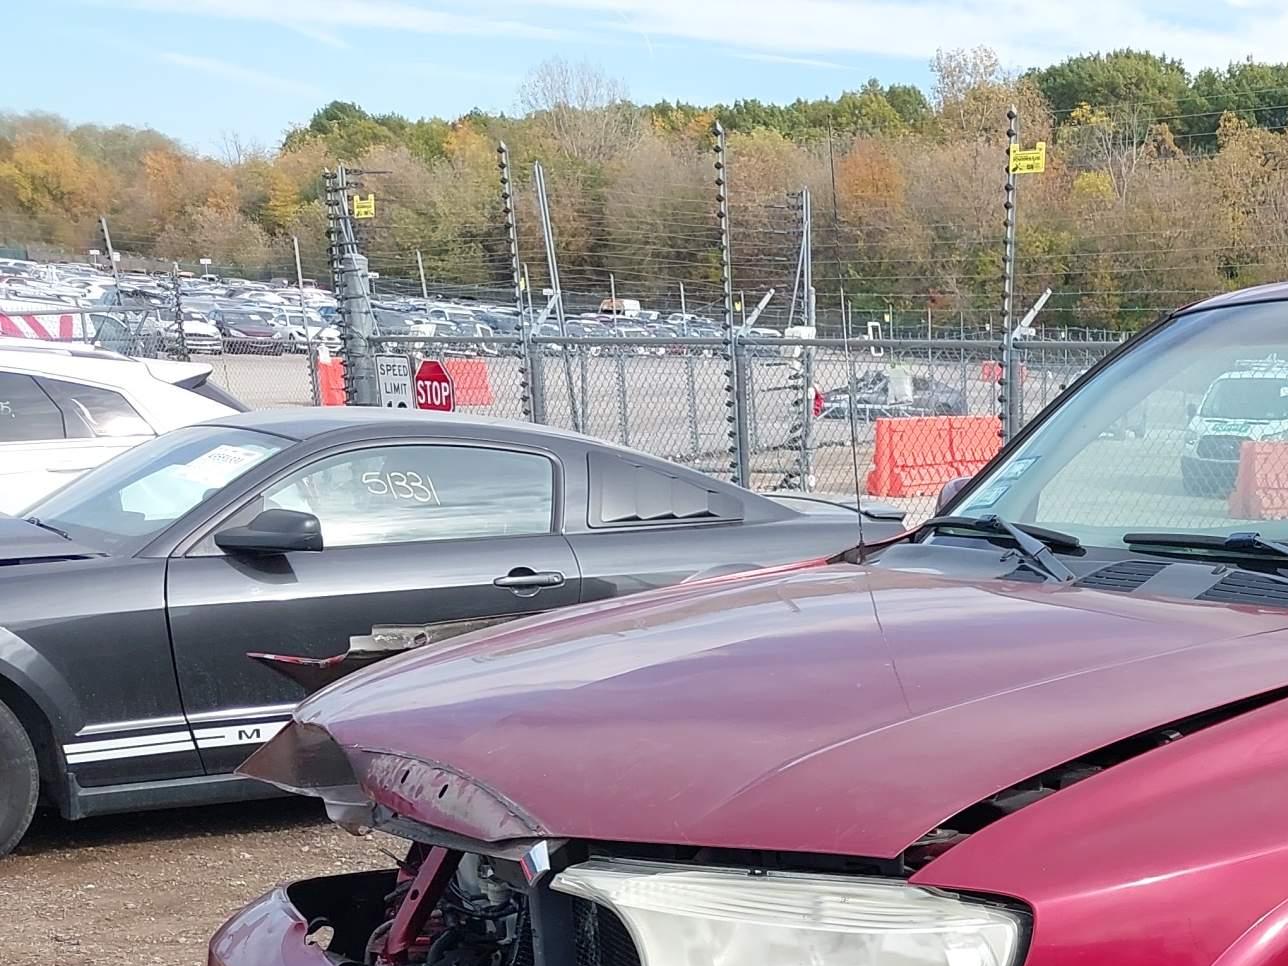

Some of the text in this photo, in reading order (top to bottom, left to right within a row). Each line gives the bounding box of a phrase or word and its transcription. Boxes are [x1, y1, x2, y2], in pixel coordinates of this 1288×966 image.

[379, 364, 408, 376] SPEED
[384, 382, 407, 395] LIMIT
[416, 380, 450, 405] STOP
[362, 471, 441, 506] 51331
